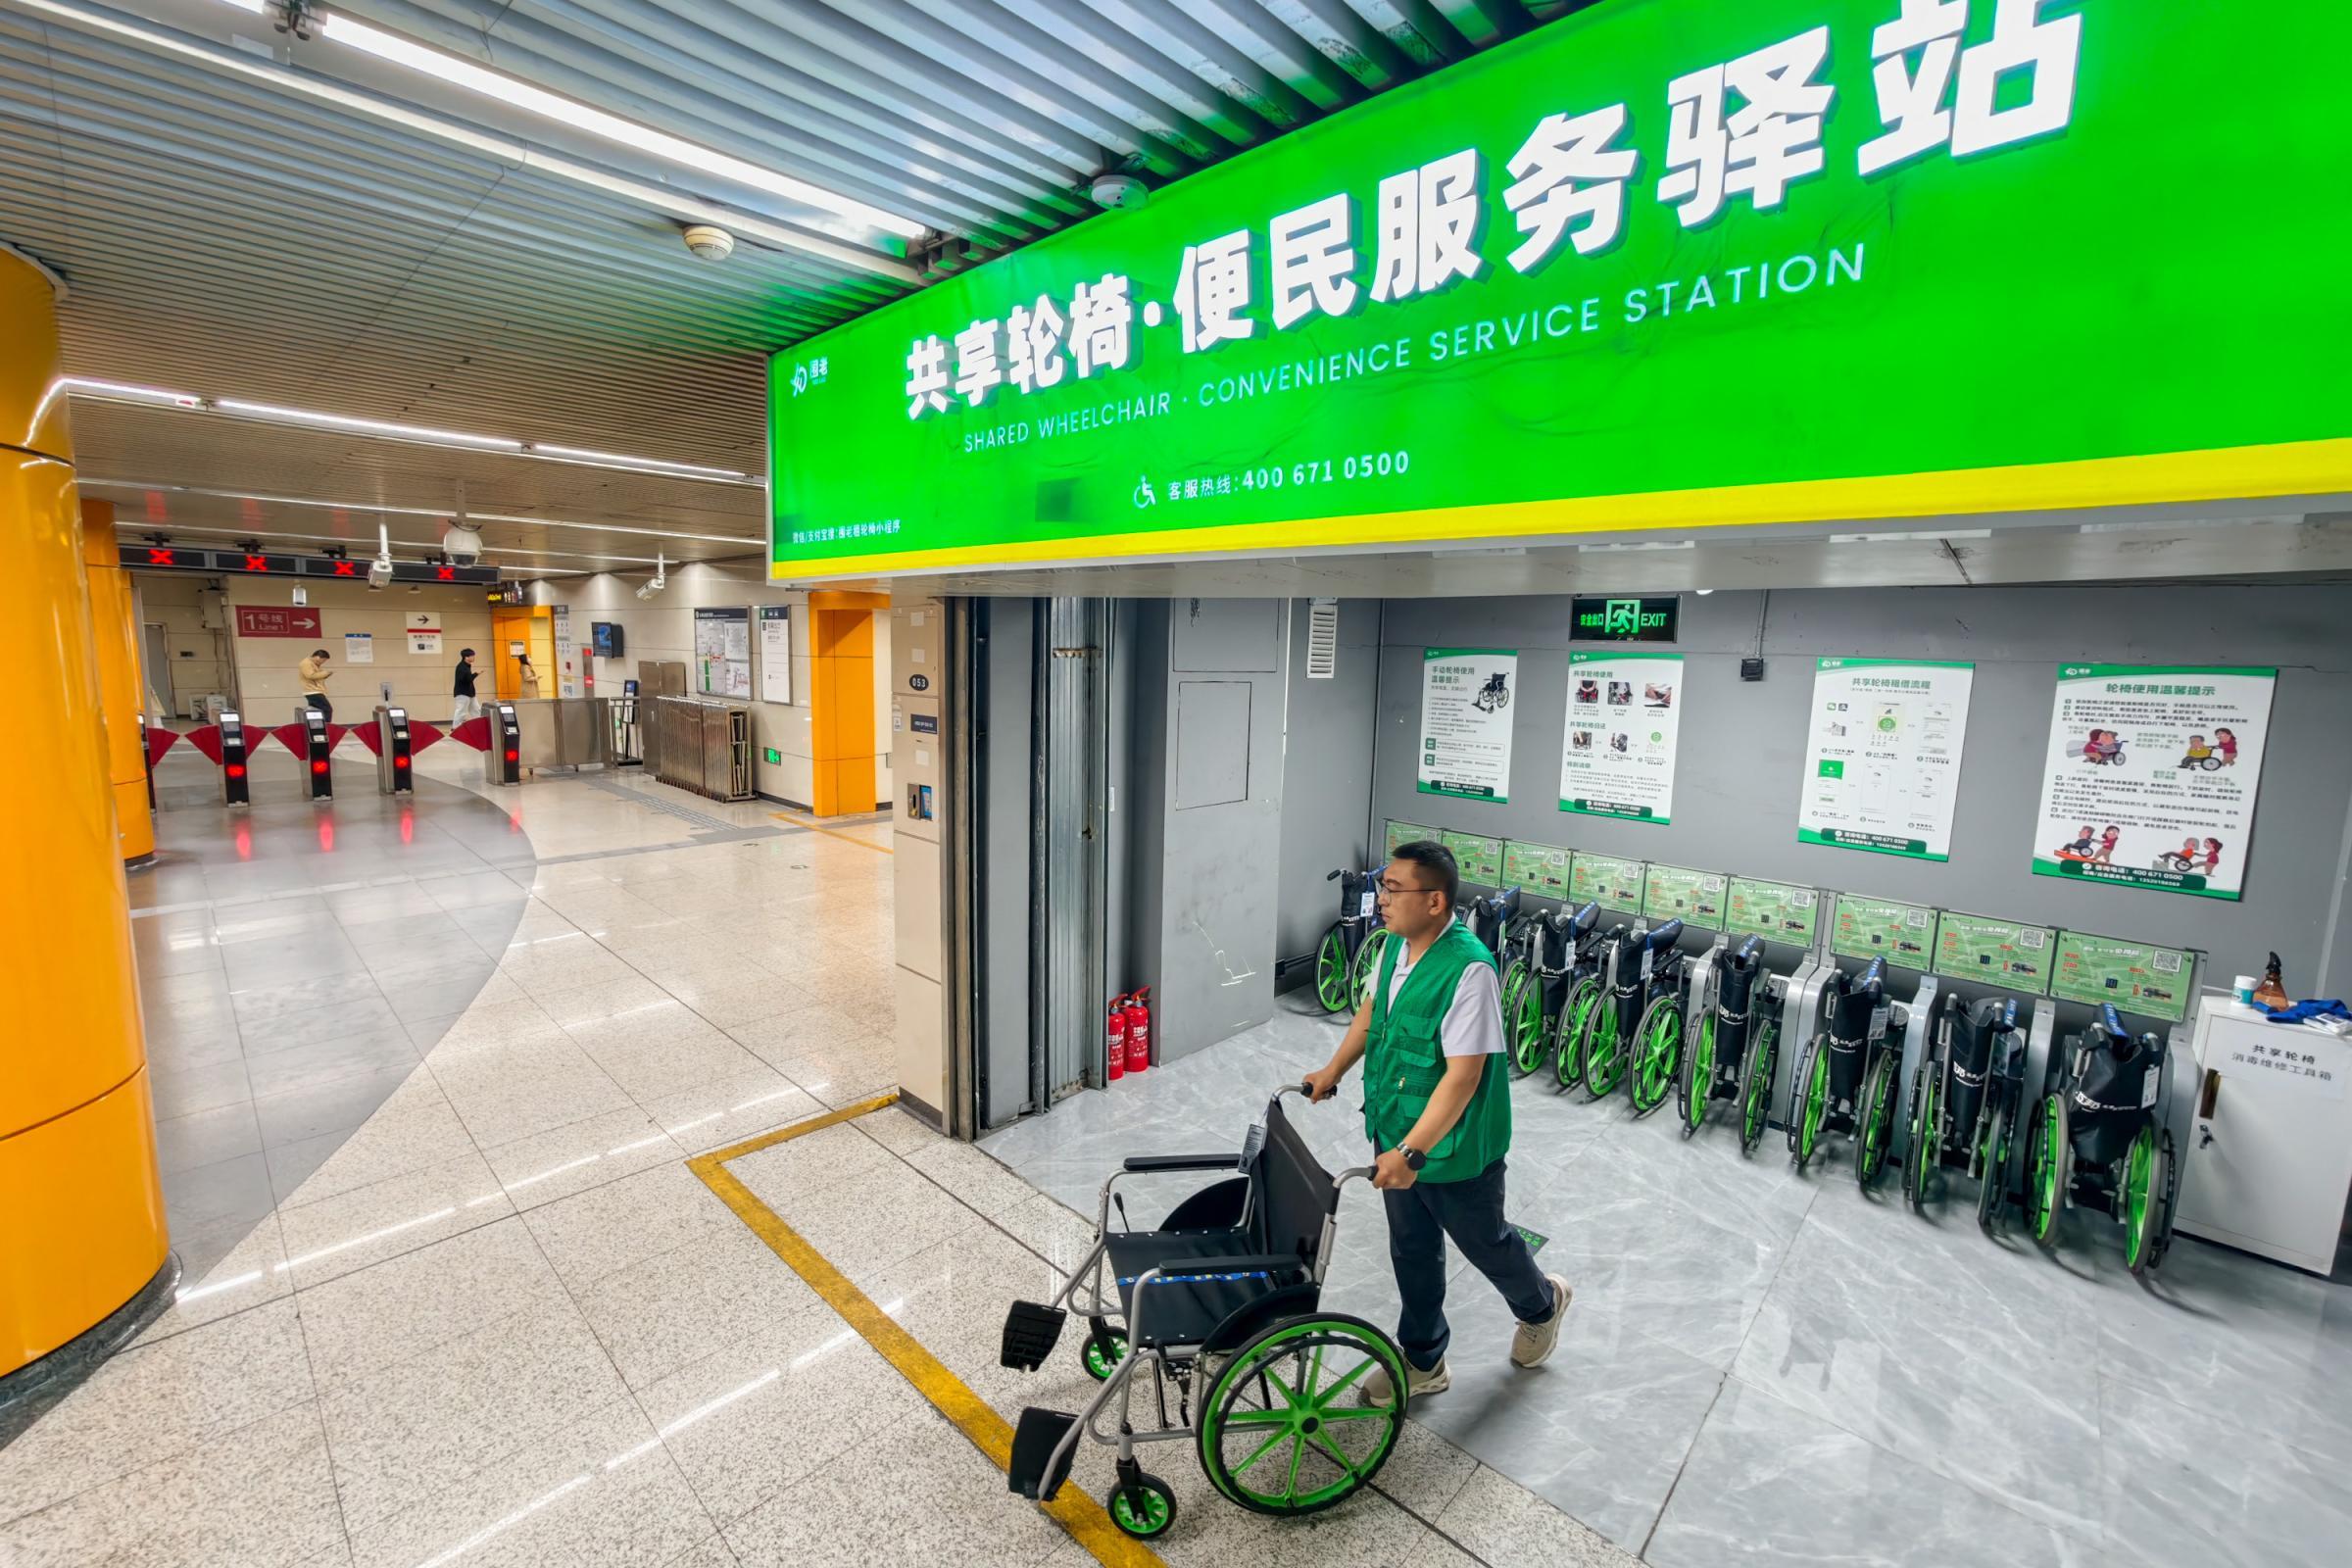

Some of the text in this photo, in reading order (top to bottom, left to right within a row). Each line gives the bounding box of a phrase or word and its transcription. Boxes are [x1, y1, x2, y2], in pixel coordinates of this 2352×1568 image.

[906, 0, 2083, 419] 共享轮椅·便民服务驿站
[964, 421, 1029, 453] SHARED
[1038, 392, 1171, 439] WHEELCHAIR
[1198, 338, 1411, 407] CONVENIENCE
[1429, 297, 1599, 361] SERVICE
[1623, 242, 1864, 322] STATION
[1292, 460, 1333, 486] 671
[1344, 451, 1409, 479] 0500
[1580, 613, 1604, 626] 安全出口
[1641, 612, 1667, 627] EXIT
[911, 677, 926, 688] 053
[1852, 677, 1931, 690] 共享轮椅租借流程
[2106, 683, 2216, 696] 轮椅使用温馨提示
[2253, 1044, 2316, 1065] 共享轮椅
[2231, 1053, 2332, 1081] 消毒维修工具箱
